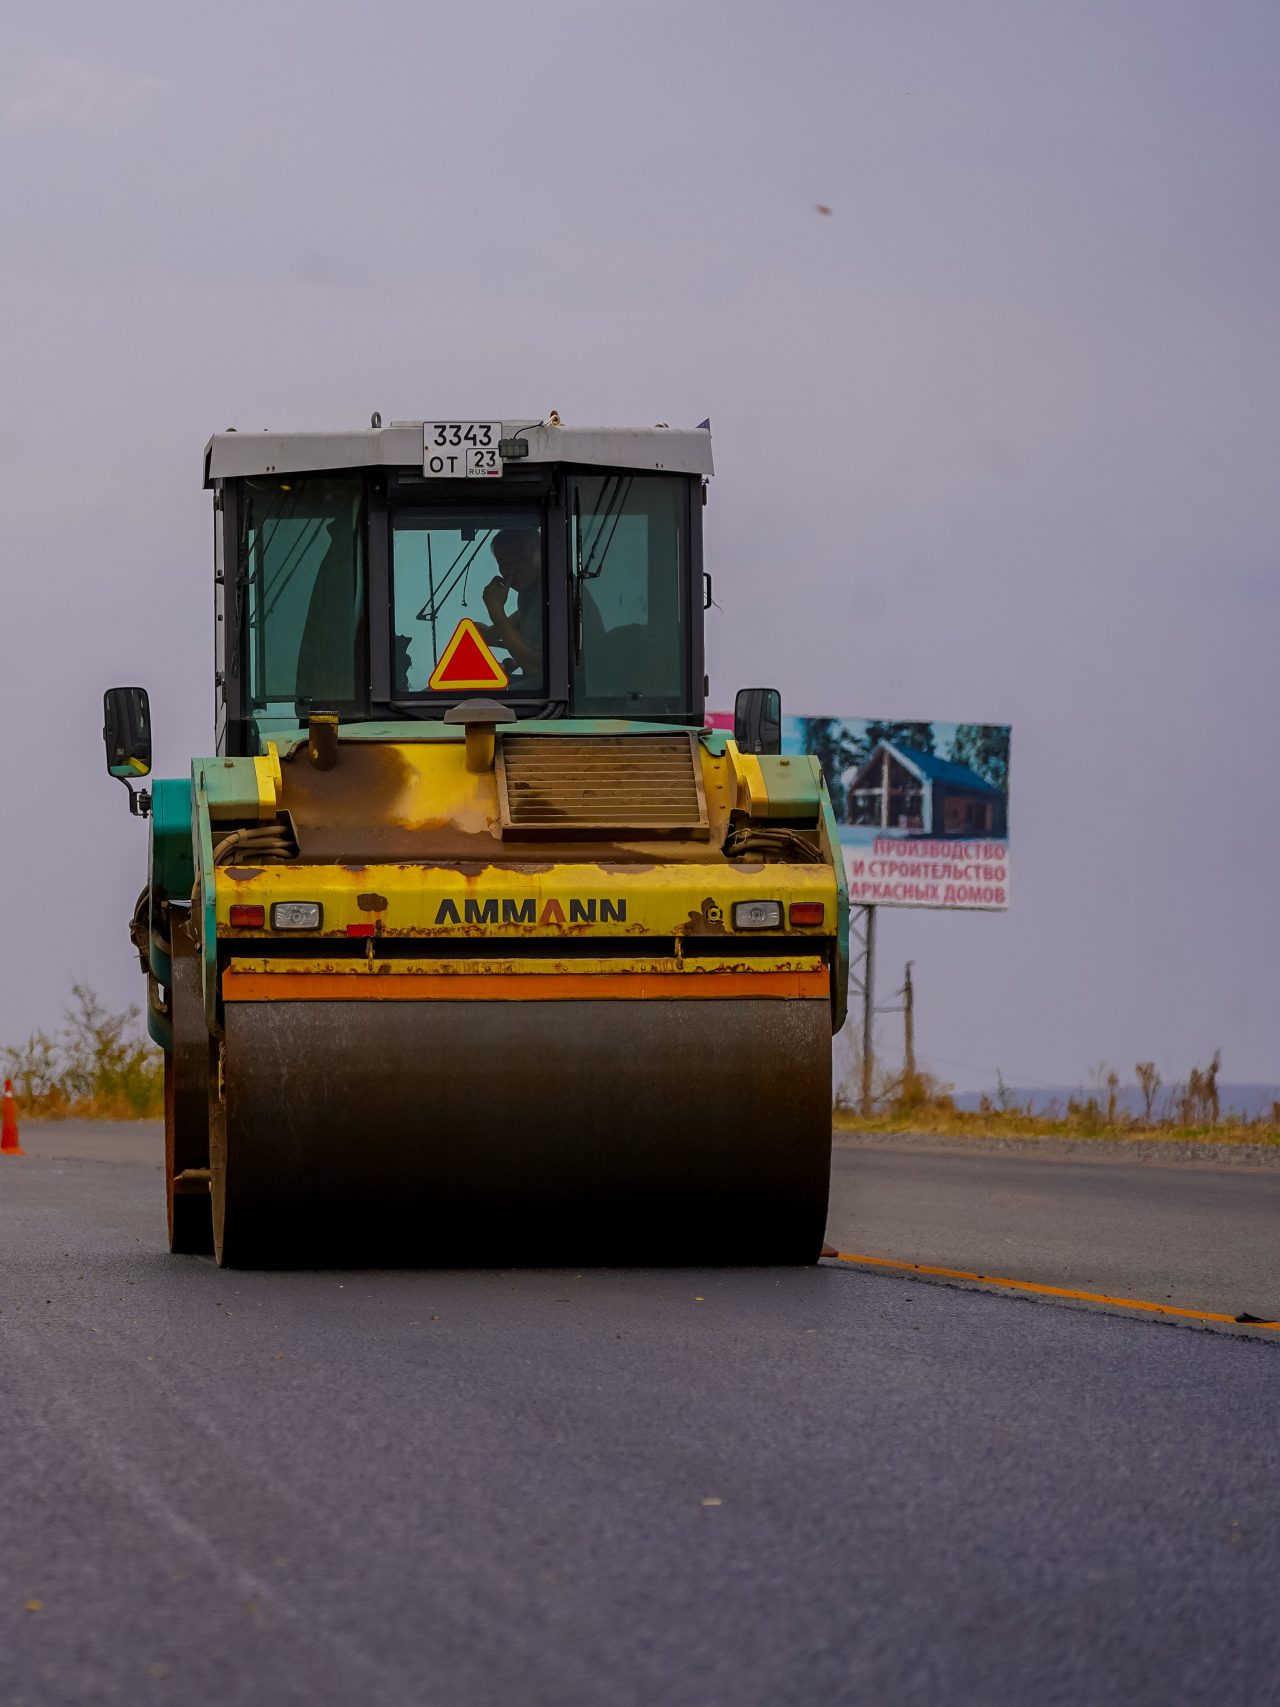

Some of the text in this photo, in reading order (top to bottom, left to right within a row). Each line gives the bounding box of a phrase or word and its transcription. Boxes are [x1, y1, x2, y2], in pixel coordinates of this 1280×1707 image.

[433, 425, 492, 447] 3343
[474, 451, 496, 467] 23
[873, 838, 1006, 860] ПРОИЗВОДСТВО
[853, 860, 1006, 881] И СТРОИТЕЛЬСТВО
[850, 880, 1006, 905] АРКАСНЫХ ДОМОВ
[434, 899, 626, 924] AMMANN
